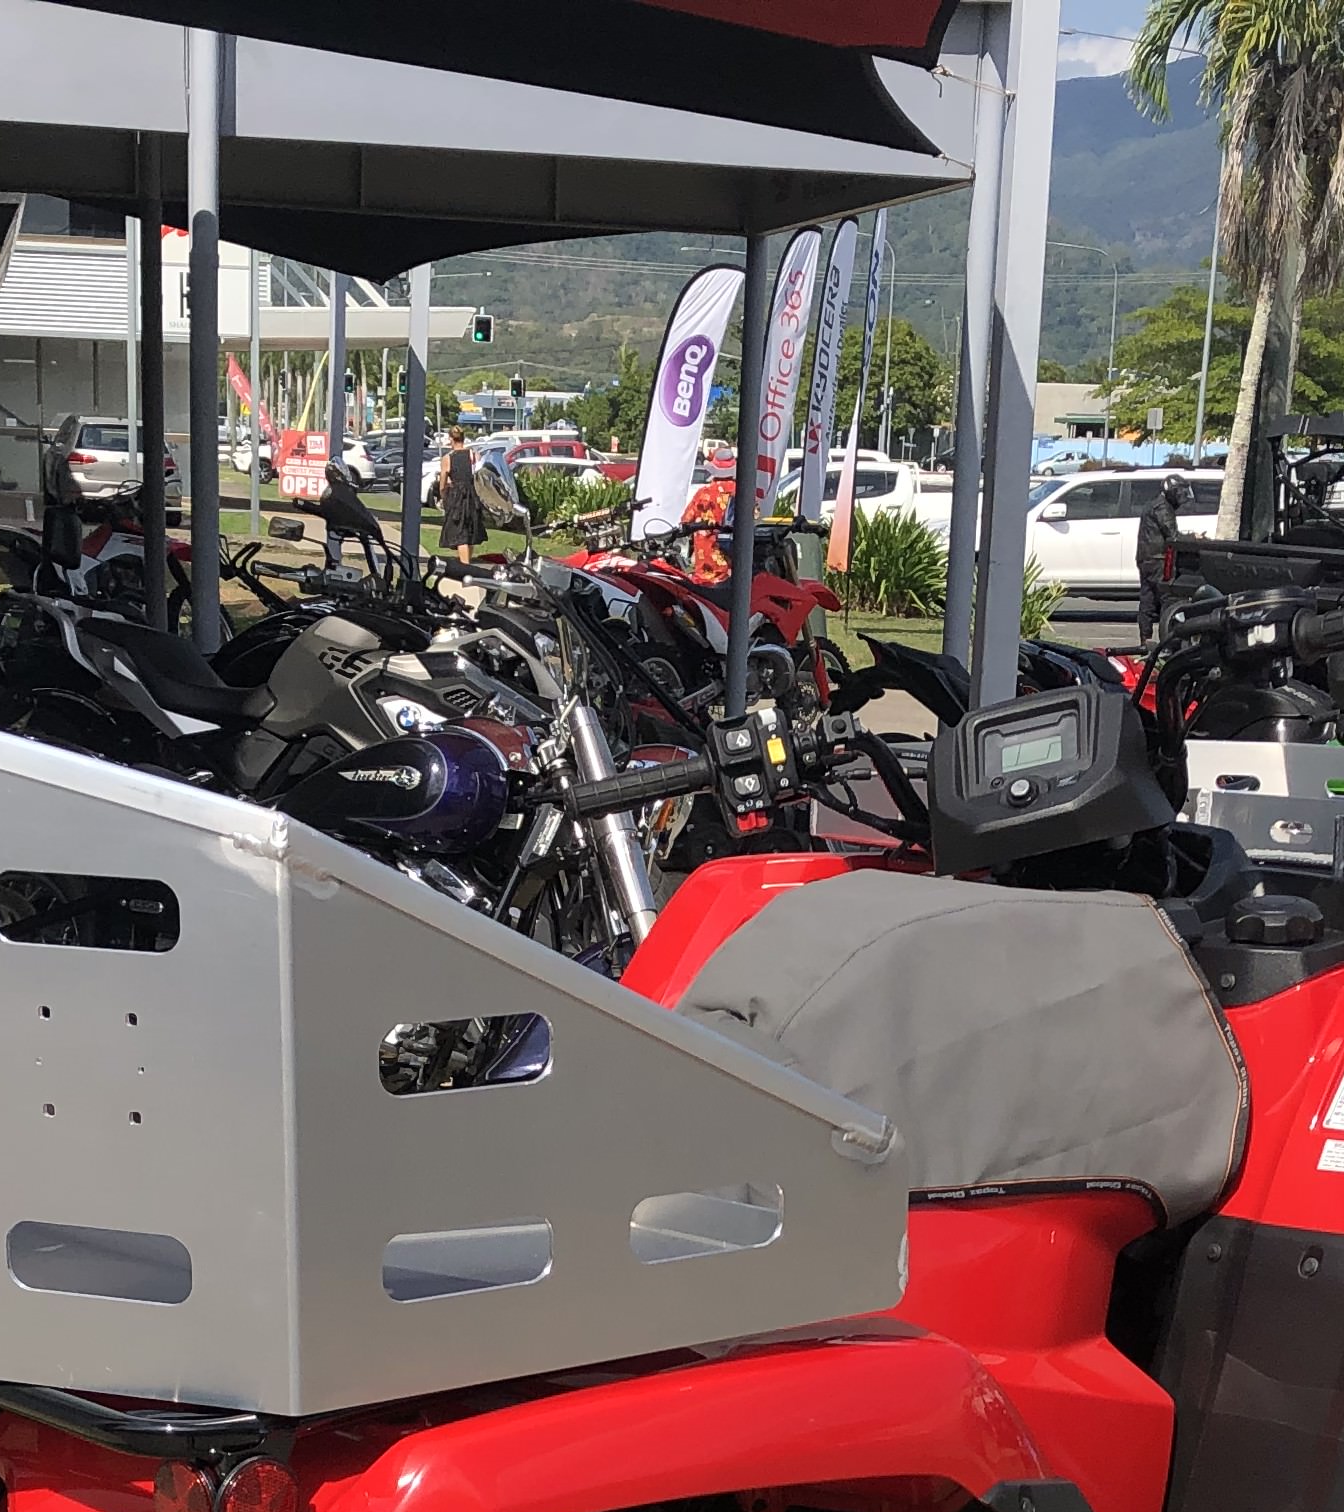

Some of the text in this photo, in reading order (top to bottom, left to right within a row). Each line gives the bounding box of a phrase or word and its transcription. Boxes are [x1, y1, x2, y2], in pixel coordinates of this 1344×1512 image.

[672, 344, 708, 418] BenQ
[759, 269, 805, 442] Office 365
[811, 264, 841, 413] KYOCERA
[282, 475, 329, 496] OPEN
